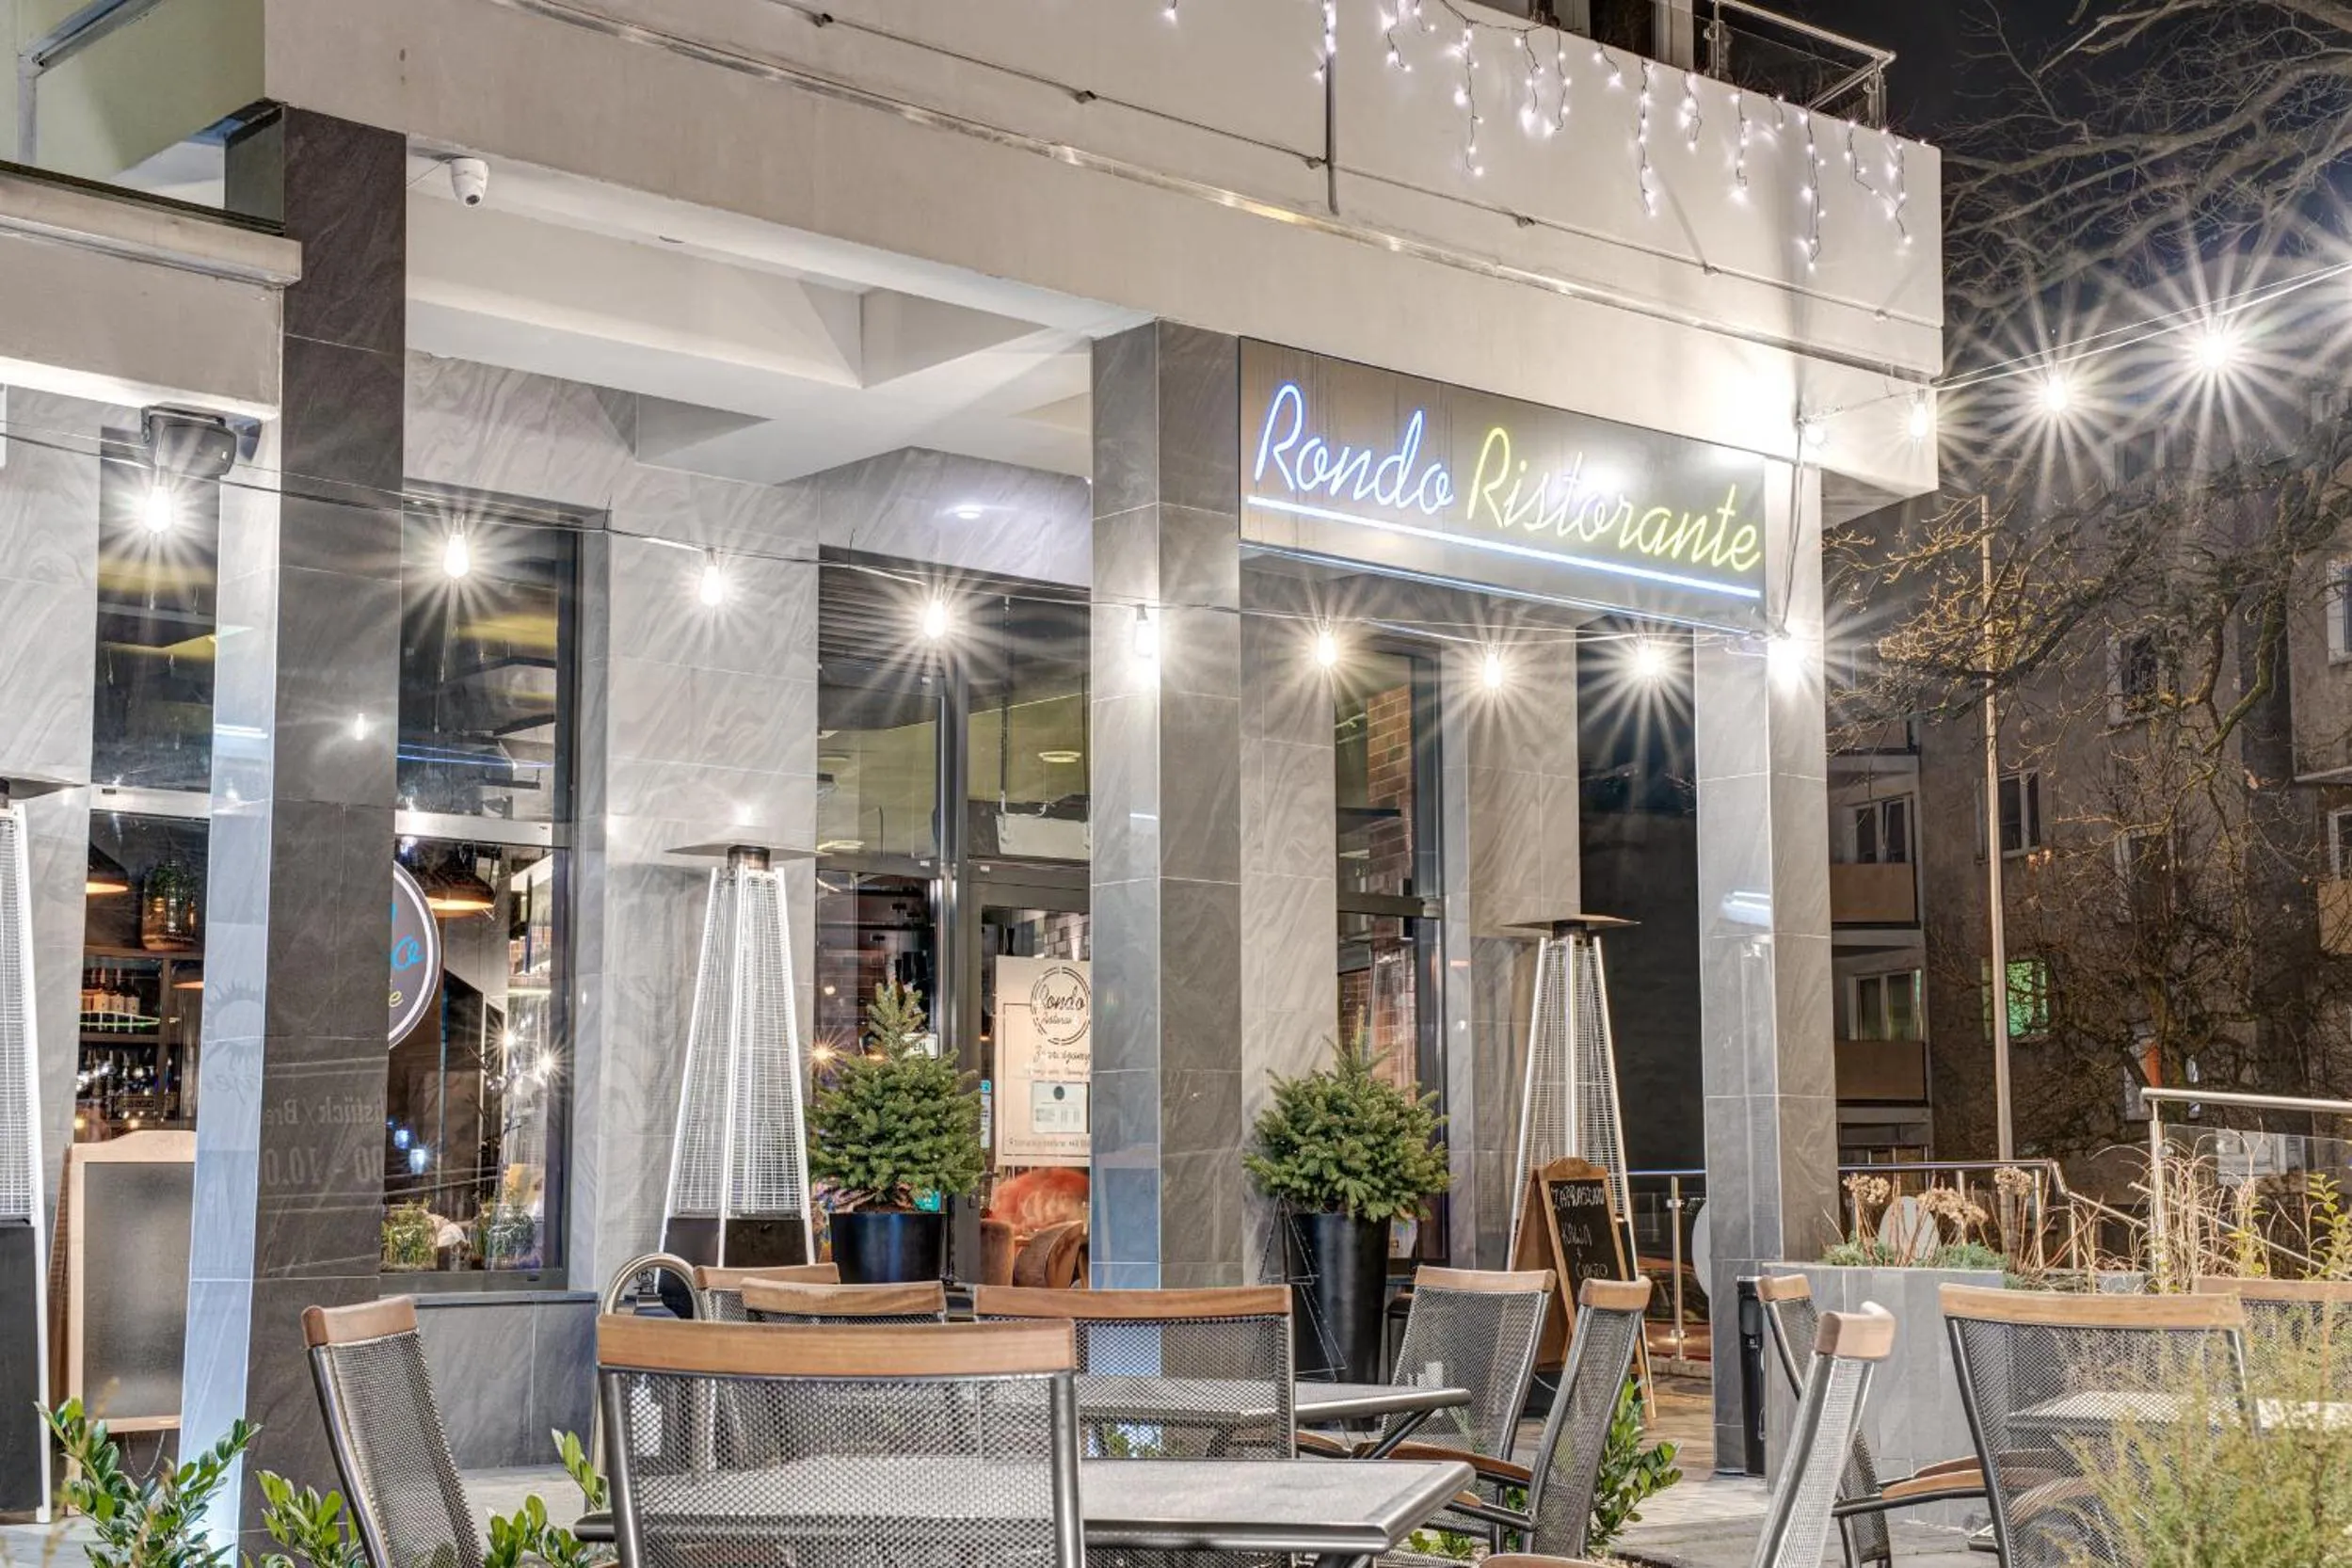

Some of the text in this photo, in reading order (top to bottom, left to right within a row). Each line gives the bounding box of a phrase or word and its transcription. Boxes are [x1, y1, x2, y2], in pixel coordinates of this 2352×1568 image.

[1255, 382, 1762, 572] Rondo Ristorante
[1039, 983, 1085, 1011] Rondo
